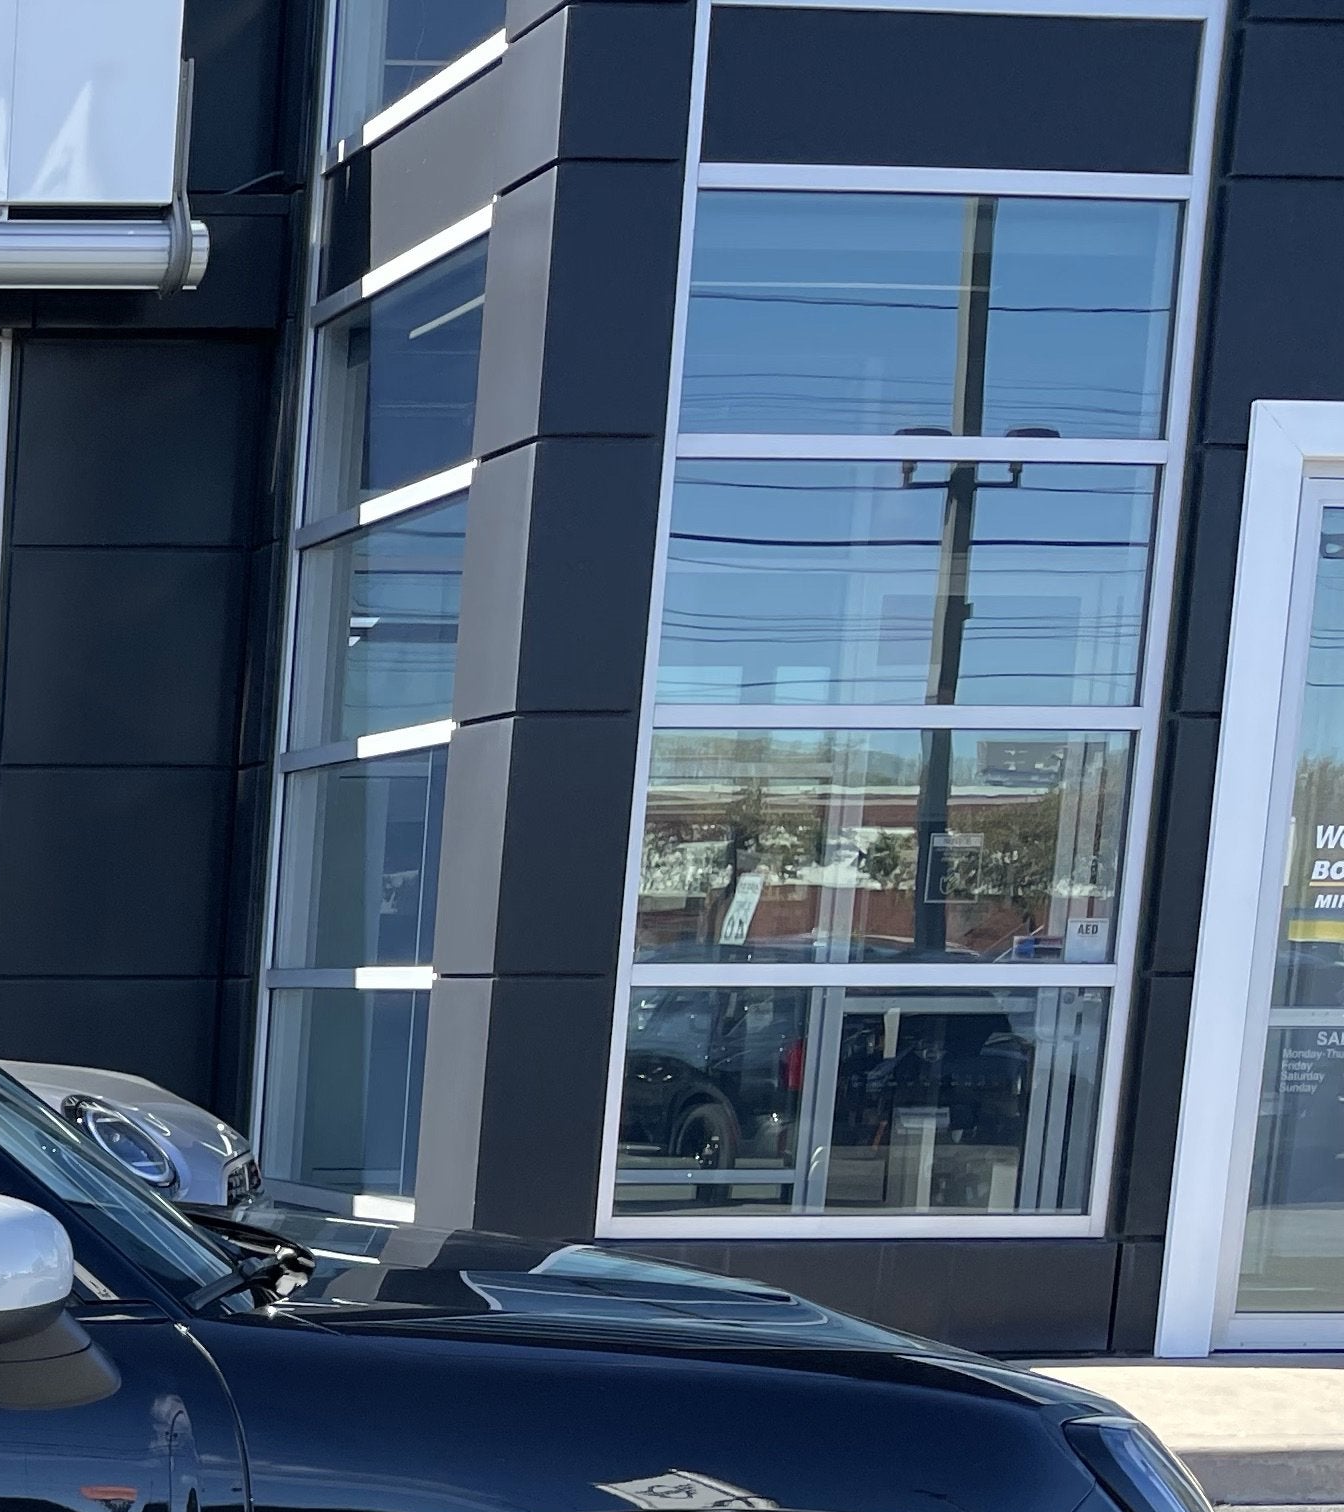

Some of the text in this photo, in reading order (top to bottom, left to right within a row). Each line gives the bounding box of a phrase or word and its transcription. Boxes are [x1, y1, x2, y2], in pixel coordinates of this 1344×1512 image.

[1077, 923, 1099, 935] AED
[1282, 1060, 1313, 1072] Friday
[1281, 1071, 1325, 1083] Saturday
[1279, 1082, 1318, 1095] Sunday
